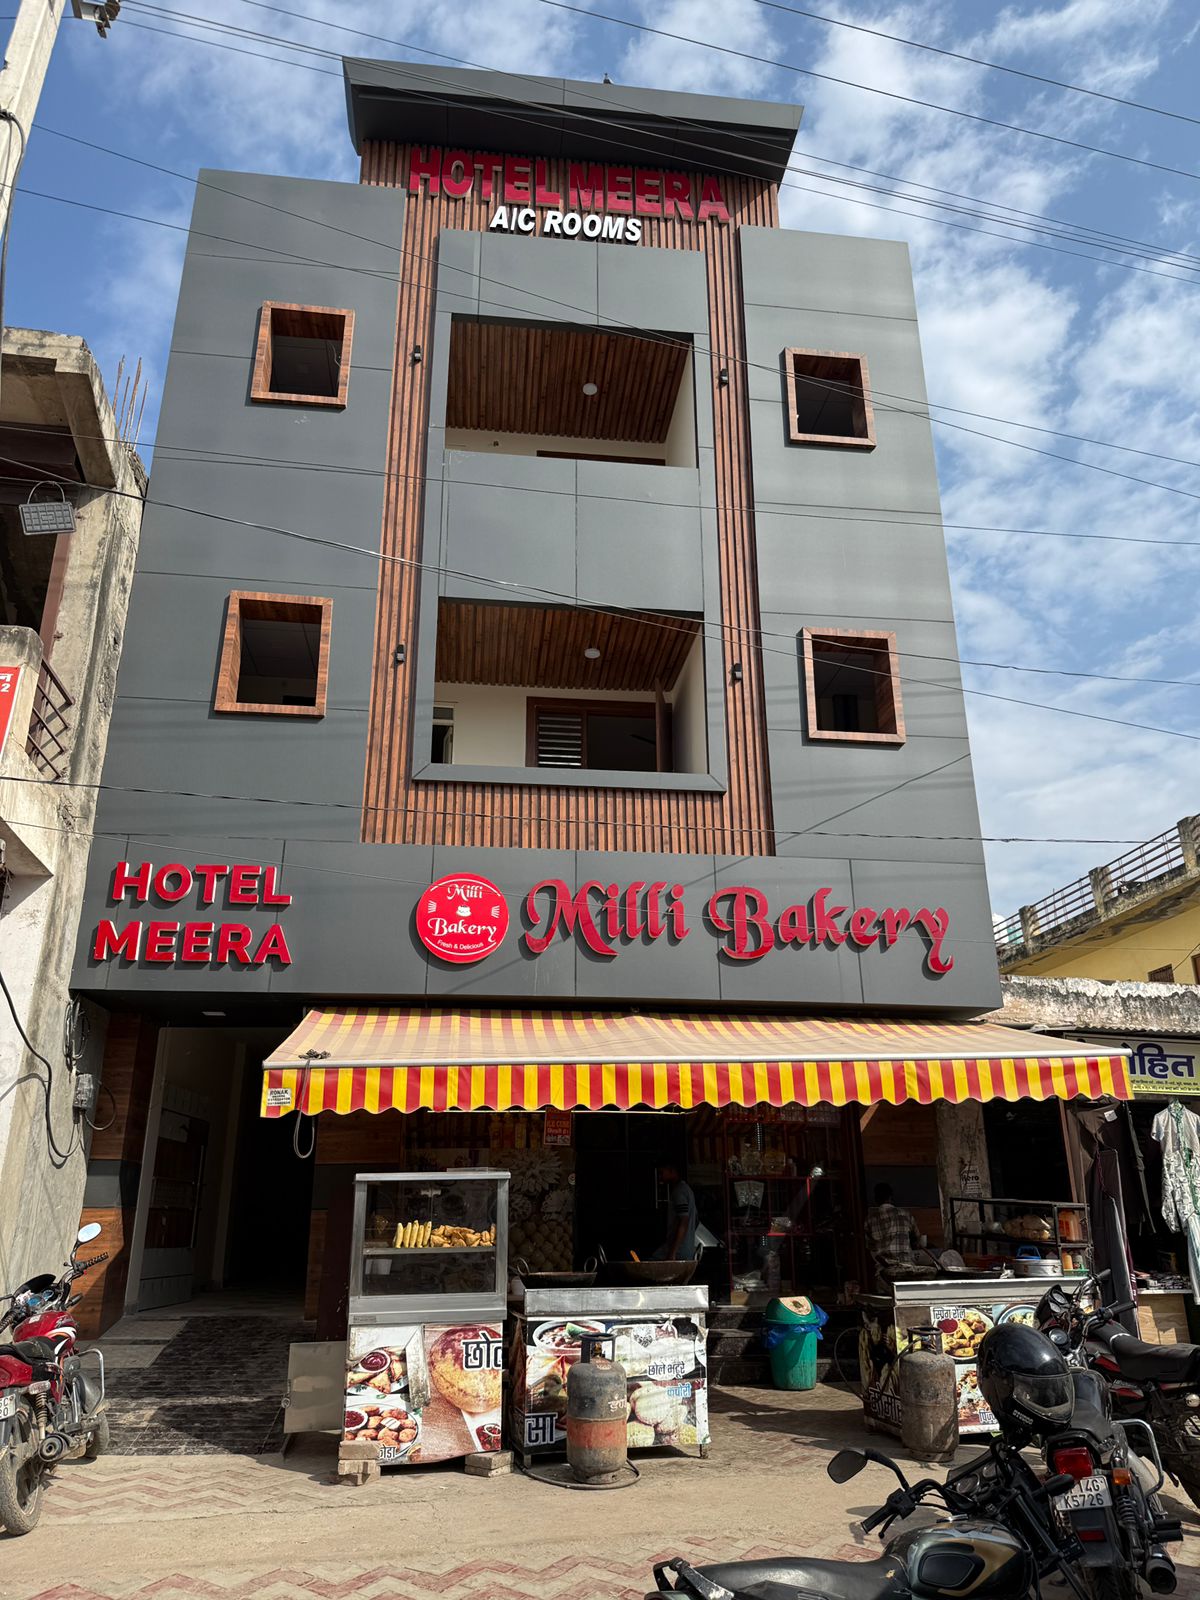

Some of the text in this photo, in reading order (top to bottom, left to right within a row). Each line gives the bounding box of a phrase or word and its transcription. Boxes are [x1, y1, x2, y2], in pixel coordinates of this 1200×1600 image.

[409, 146, 730, 223] HOTEL MEERA
[543, 210, 642, 242] ROOMS
[111, 861, 293, 905] HOTEL
[93, 920, 293, 964] MEERA
[427, 917, 497, 942] Bakery
[437, 940, 453, 949] Fresh
[460, 941, 484, 950] Delicious
[525, 879, 954, 974] Milli Bakery
[1063, 1493, 1104, 1508] K5726
